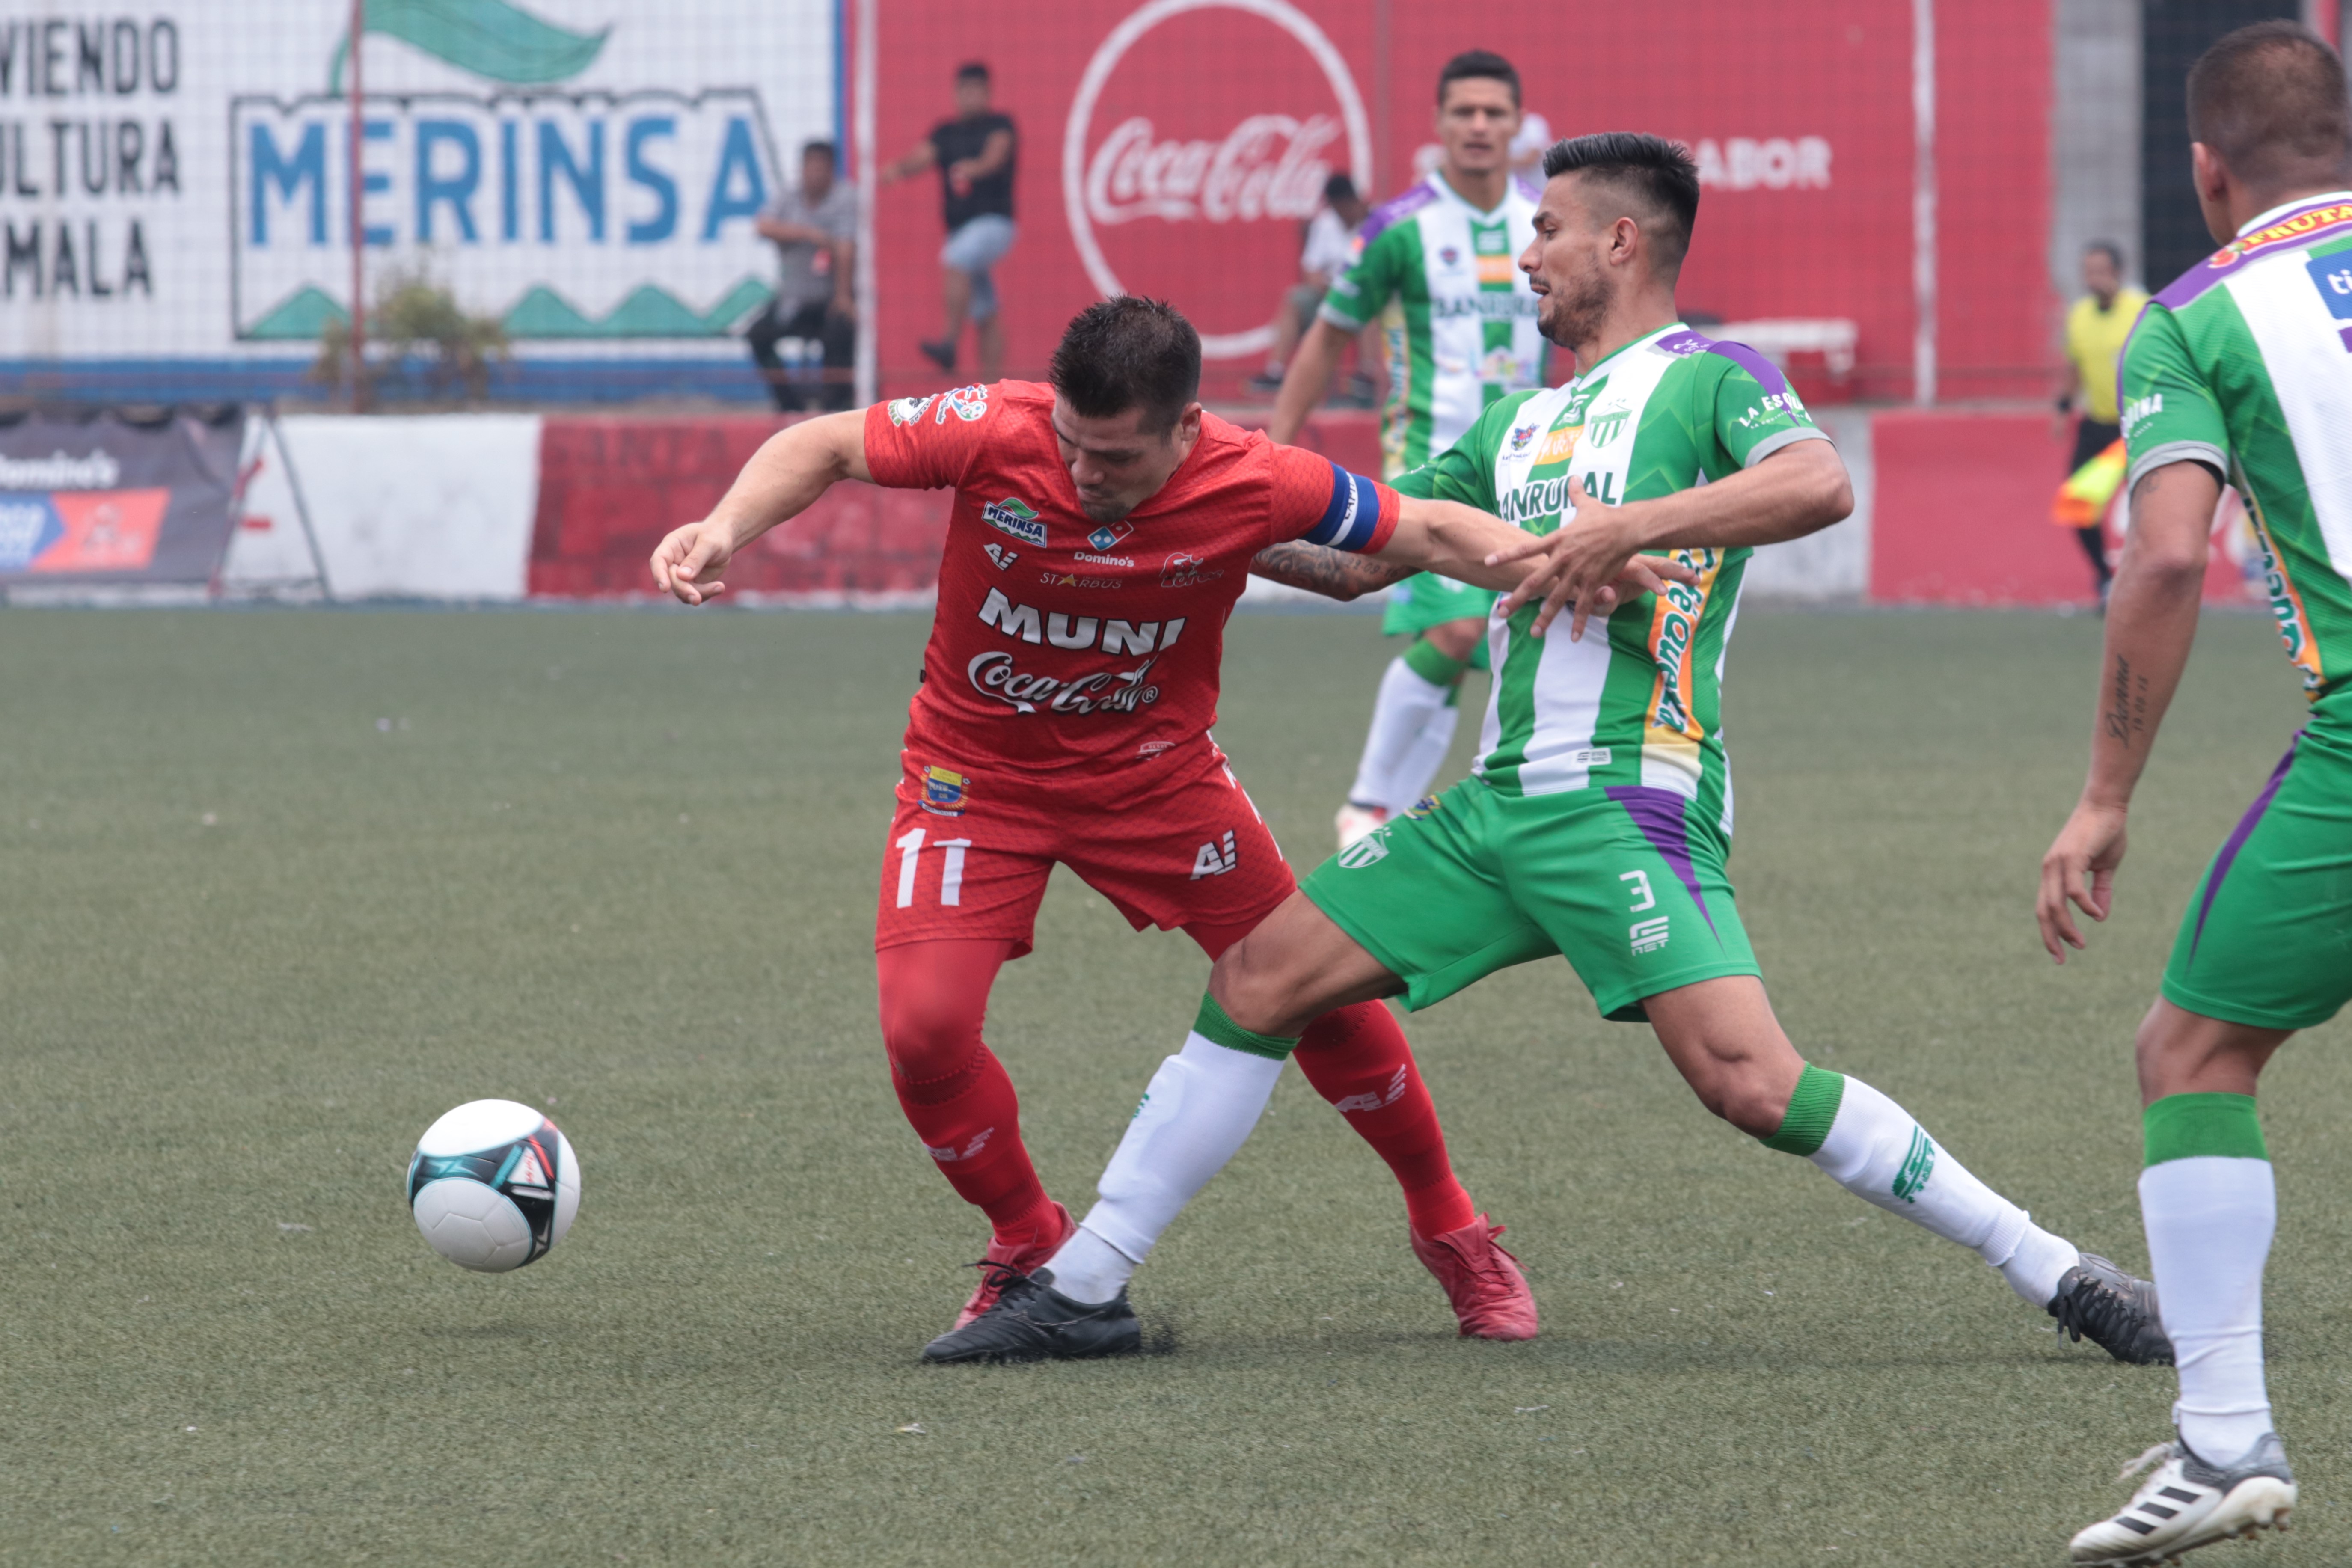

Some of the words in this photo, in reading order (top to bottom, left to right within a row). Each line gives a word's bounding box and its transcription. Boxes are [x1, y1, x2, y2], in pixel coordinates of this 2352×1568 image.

[0, 121, 180, 196] LTURA
[249, 117, 769, 245] MERINSA
[1671, 136, 1835, 191] ABOR
[3, 218, 152, 297] MALA
[988, 506, 1043, 537] MERINSA
[1073, 551, 1134, 567] Domino's
[978, 586, 1187, 656] MUNI
[895, 827, 972, 909] 11
[1619, 870, 1656, 913] 3
